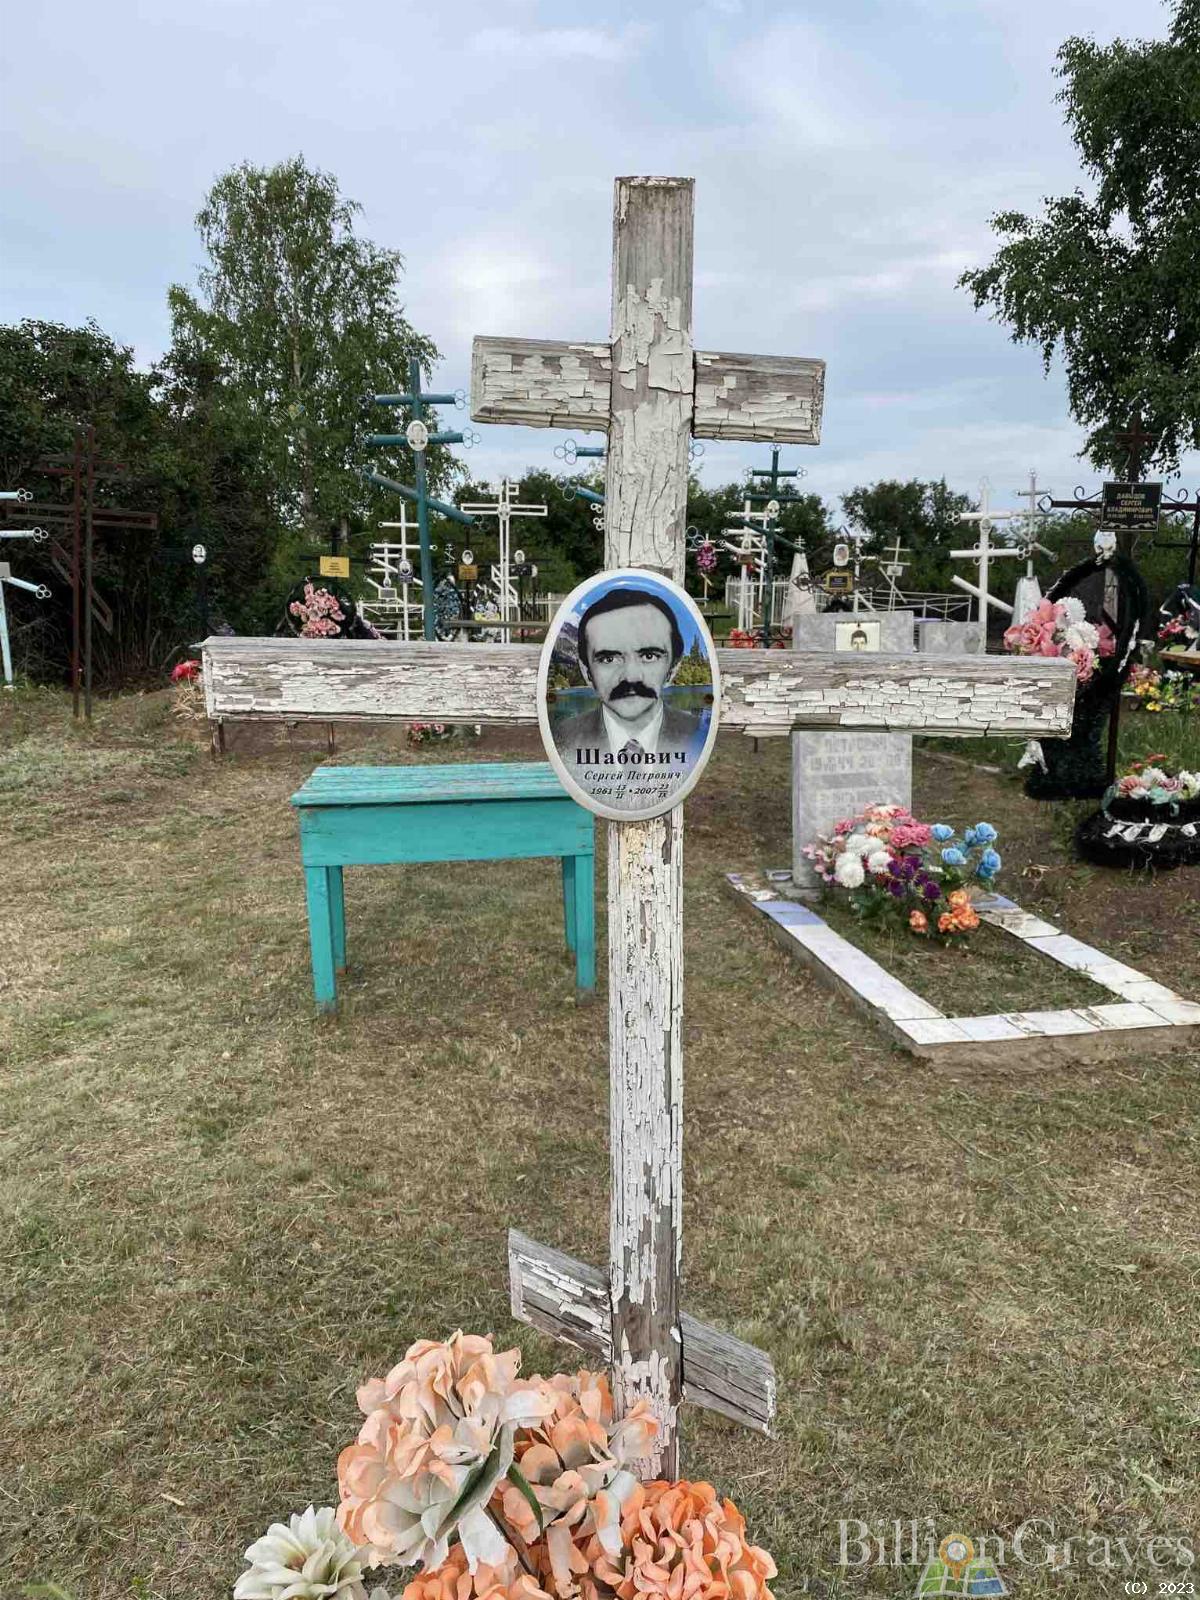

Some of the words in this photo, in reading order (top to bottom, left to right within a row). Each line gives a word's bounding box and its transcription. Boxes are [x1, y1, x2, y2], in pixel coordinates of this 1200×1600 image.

[576, 748, 687, 765] Шабович
[585, 770, 623, 782] Сергей
[627, 770, 681, 782] Петрович
[590, 787, 612, 795] 1961
[633, 787, 658, 795] 2007
